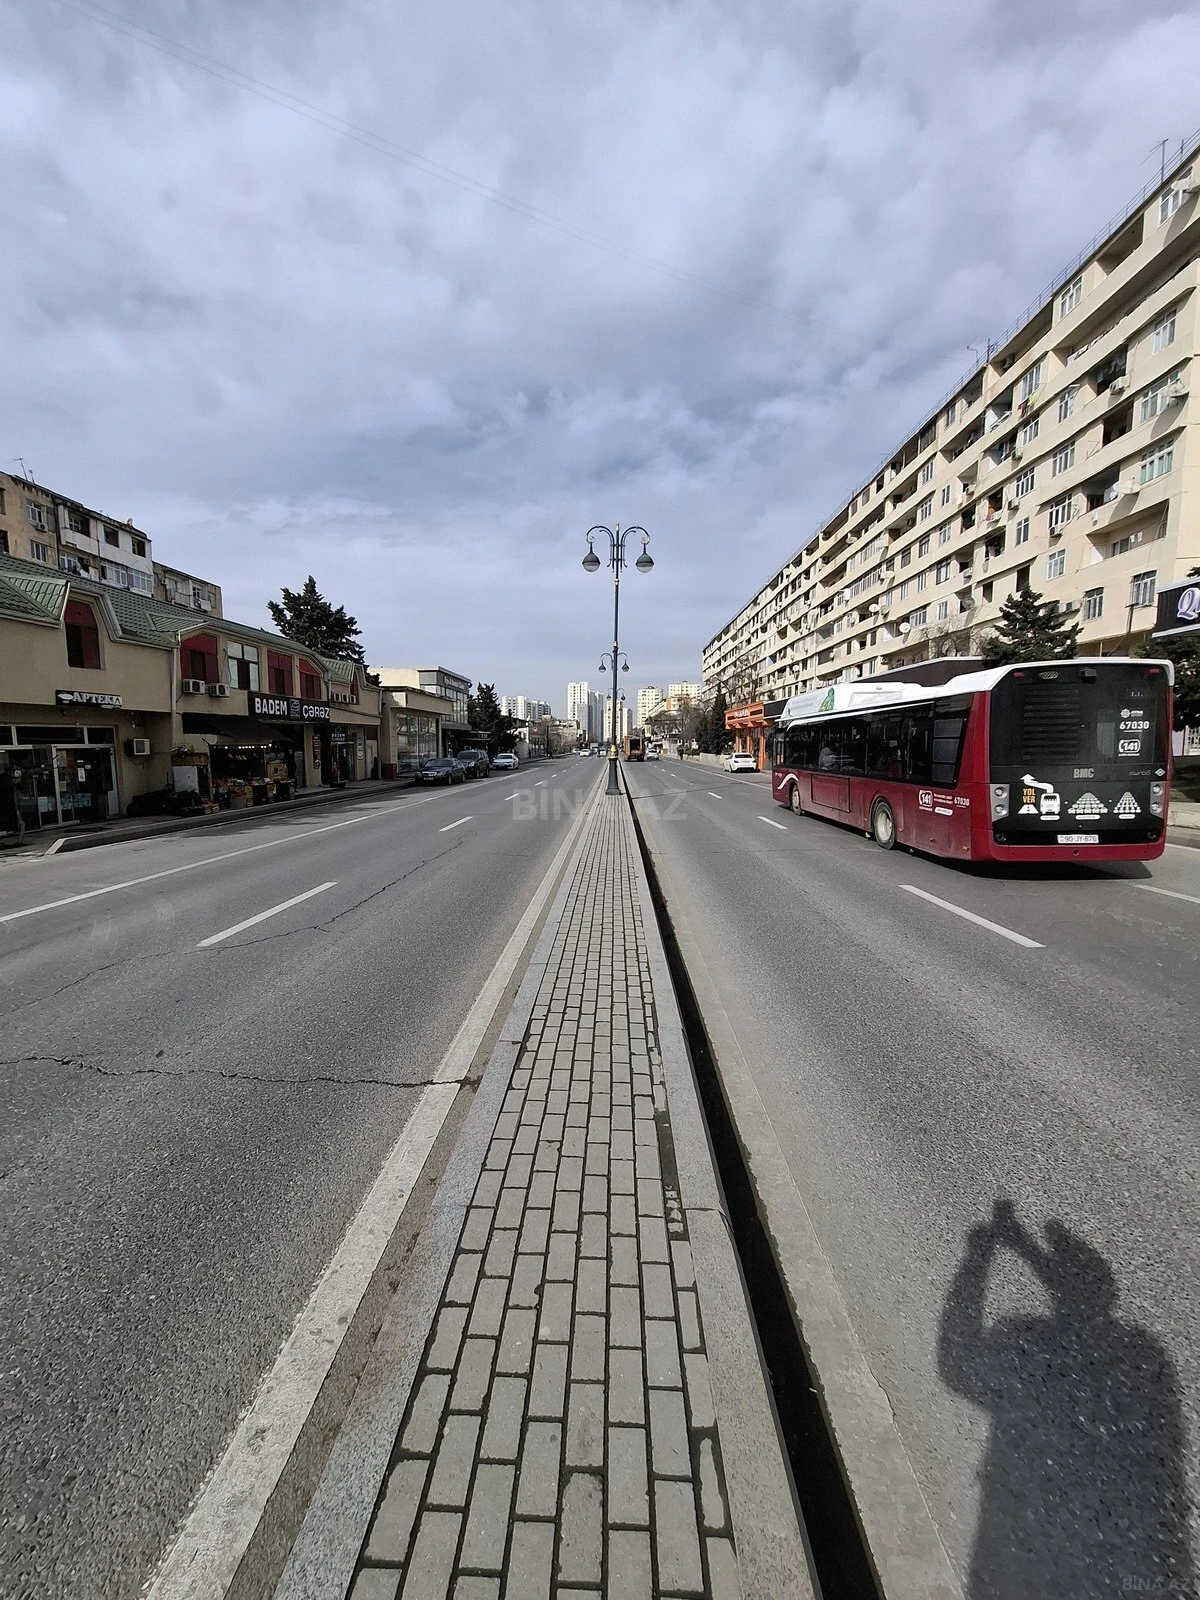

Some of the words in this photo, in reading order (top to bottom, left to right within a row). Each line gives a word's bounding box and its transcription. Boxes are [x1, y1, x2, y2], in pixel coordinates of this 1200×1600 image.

[72, 691, 122, 705] APTEKA
[254, 697, 288, 716] BADEM
[1119, 720, 1150, 730] 67030
[1123, 742, 1138, 751] 141
[1073, 768, 1095, 779] BMC
[1022, 788, 1036, 796] YOL
[921, 793, 931, 804] 141
[1022, 795, 1036, 803] VER
